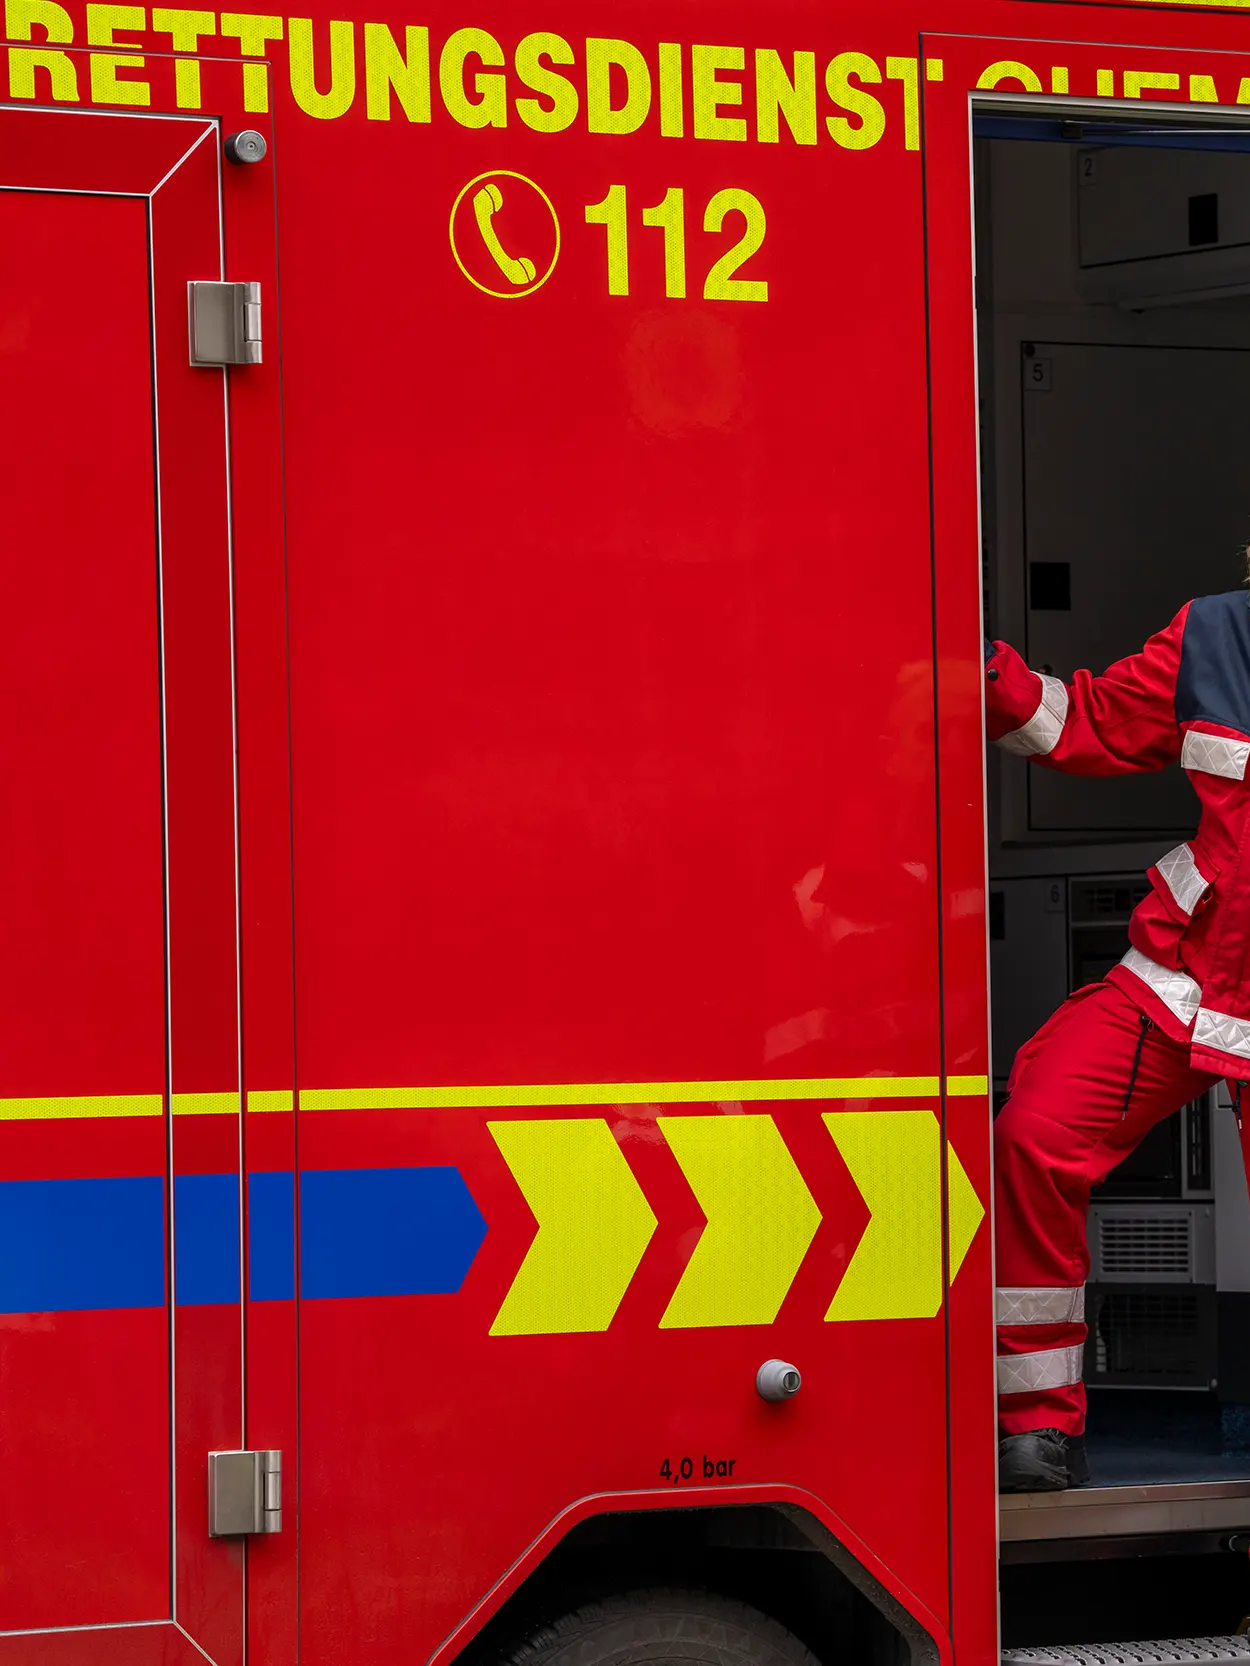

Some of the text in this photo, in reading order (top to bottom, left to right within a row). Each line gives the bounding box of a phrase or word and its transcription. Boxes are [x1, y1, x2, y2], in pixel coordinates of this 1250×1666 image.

[5, 0, 944, 151] RETTUNGSDIENST
[1084, 157, 1093, 177] 2
[584, 184, 769, 302] 112
[1033, 363, 1044, 382] 5
[1050, 884, 1060, 903] 6
[659, 1454, 736, 1484] 4,0 bar
